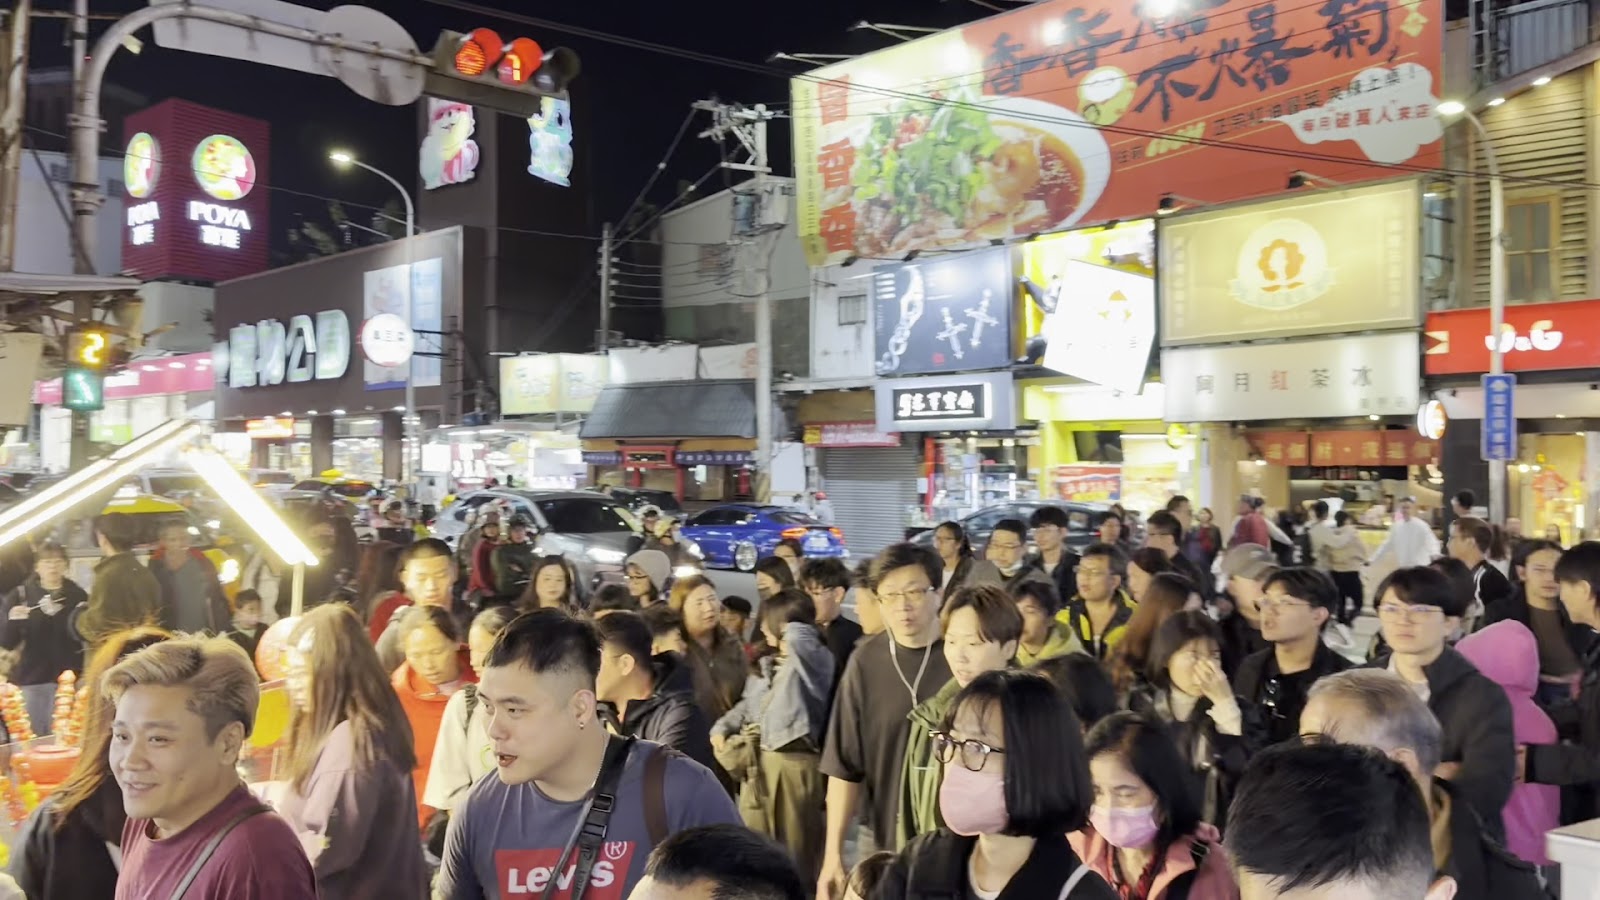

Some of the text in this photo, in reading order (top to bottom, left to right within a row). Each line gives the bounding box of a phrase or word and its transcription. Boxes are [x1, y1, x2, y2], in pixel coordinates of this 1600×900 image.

[190, 201, 251, 230] POYA
[80, 333, 104, 364] 2
[508, 860, 614, 893] Levs
